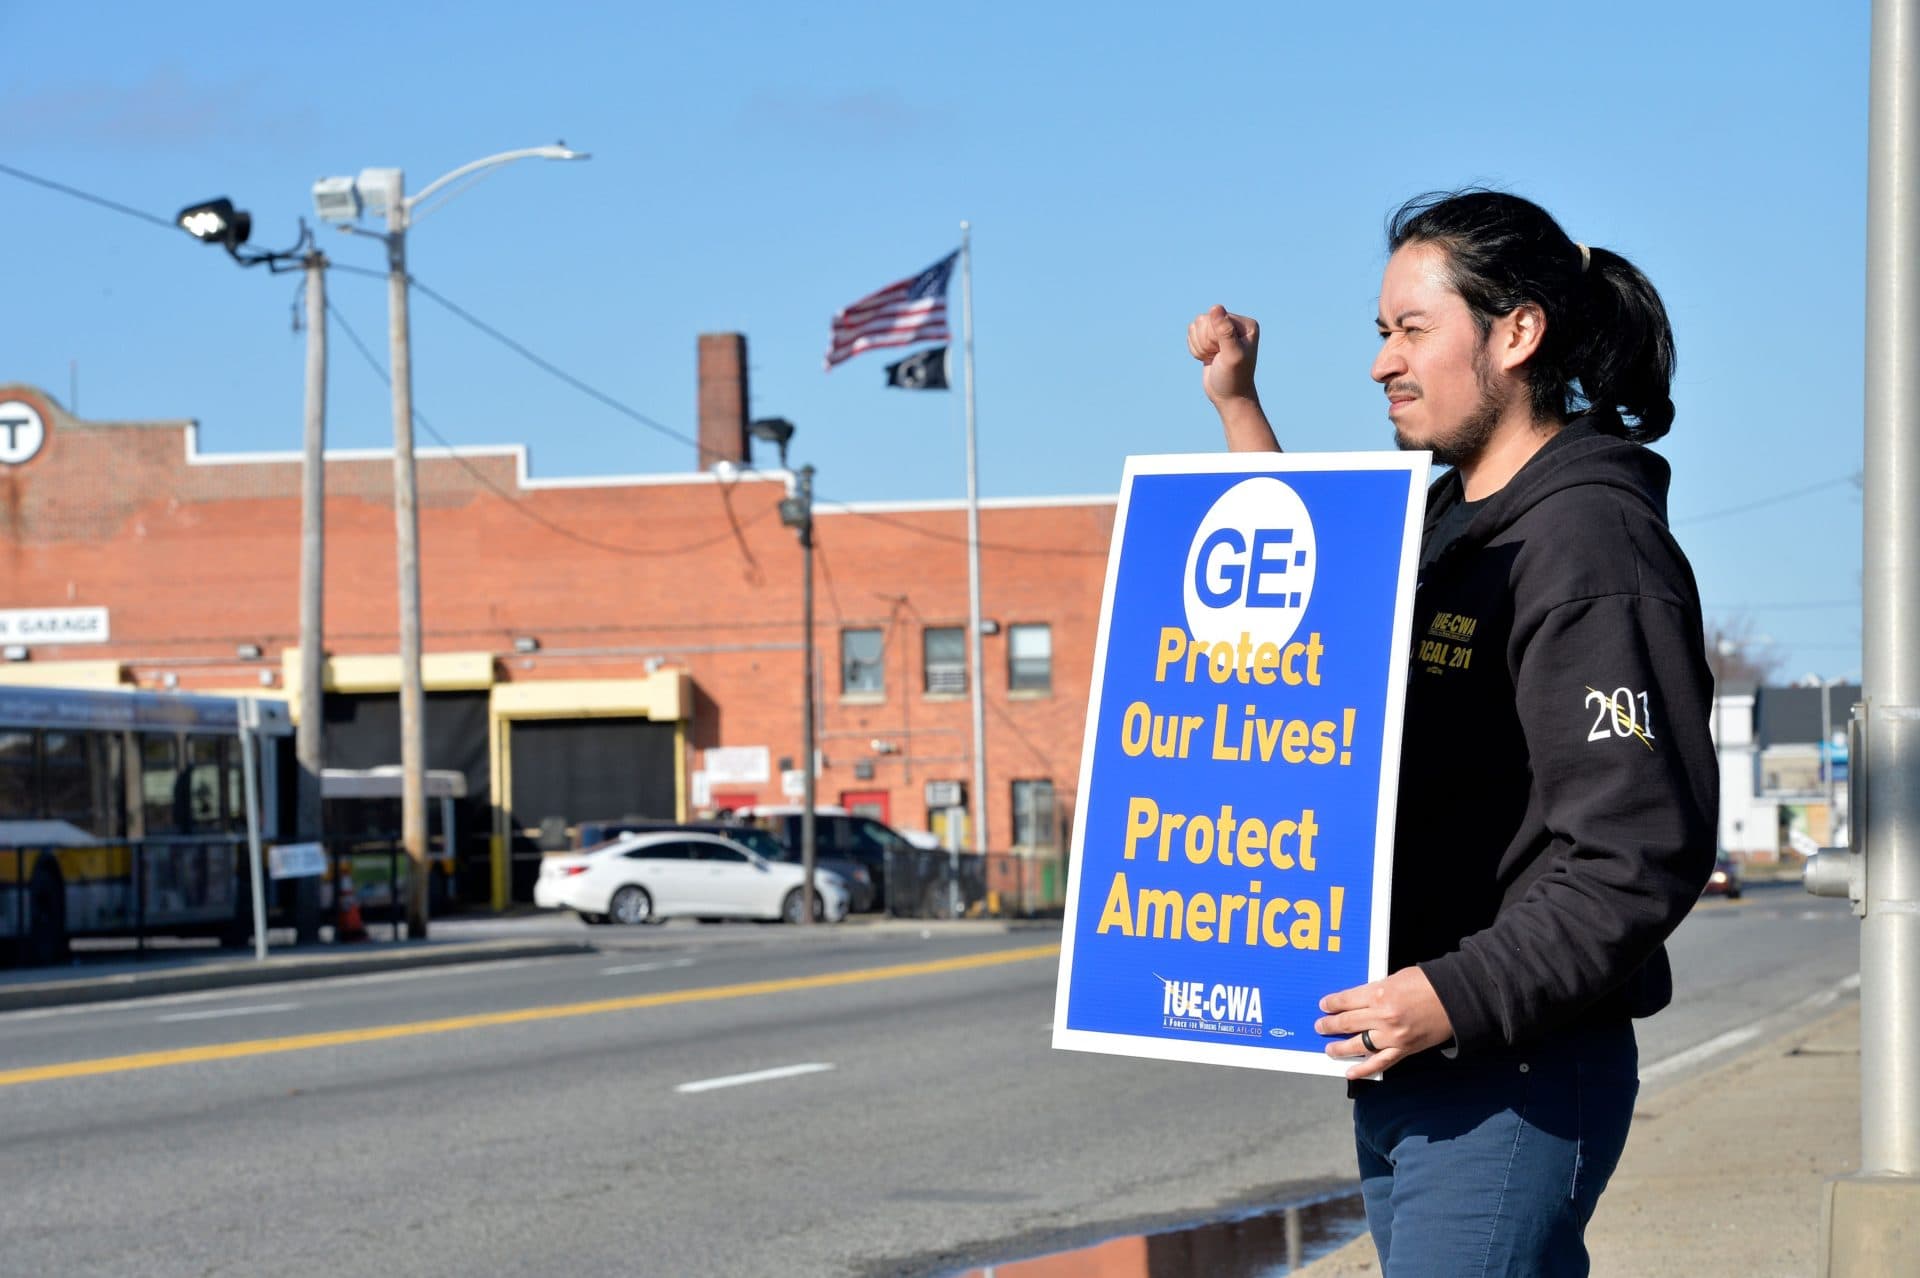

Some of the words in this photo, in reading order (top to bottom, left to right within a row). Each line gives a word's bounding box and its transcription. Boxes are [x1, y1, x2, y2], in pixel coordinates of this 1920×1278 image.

[0, 418, 30, 449] T
[1194, 527, 1308, 609] GE:
[19, 614, 98, 634] GARAGE
[1431, 610, 1478, 636] IUE-CWA
[1154, 626, 1325, 687] Protect
[1448, 646, 1473, 670] 201
[1121, 701, 1206, 759] Our
[1211, 703, 1357, 767] Lives!
[1584, 686, 1656, 743] 201
[1123, 796, 1319, 872] Protect
[1096, 872, 1345, 953] America!
[1162, 979, 1263, 1023] IUE-CWA
